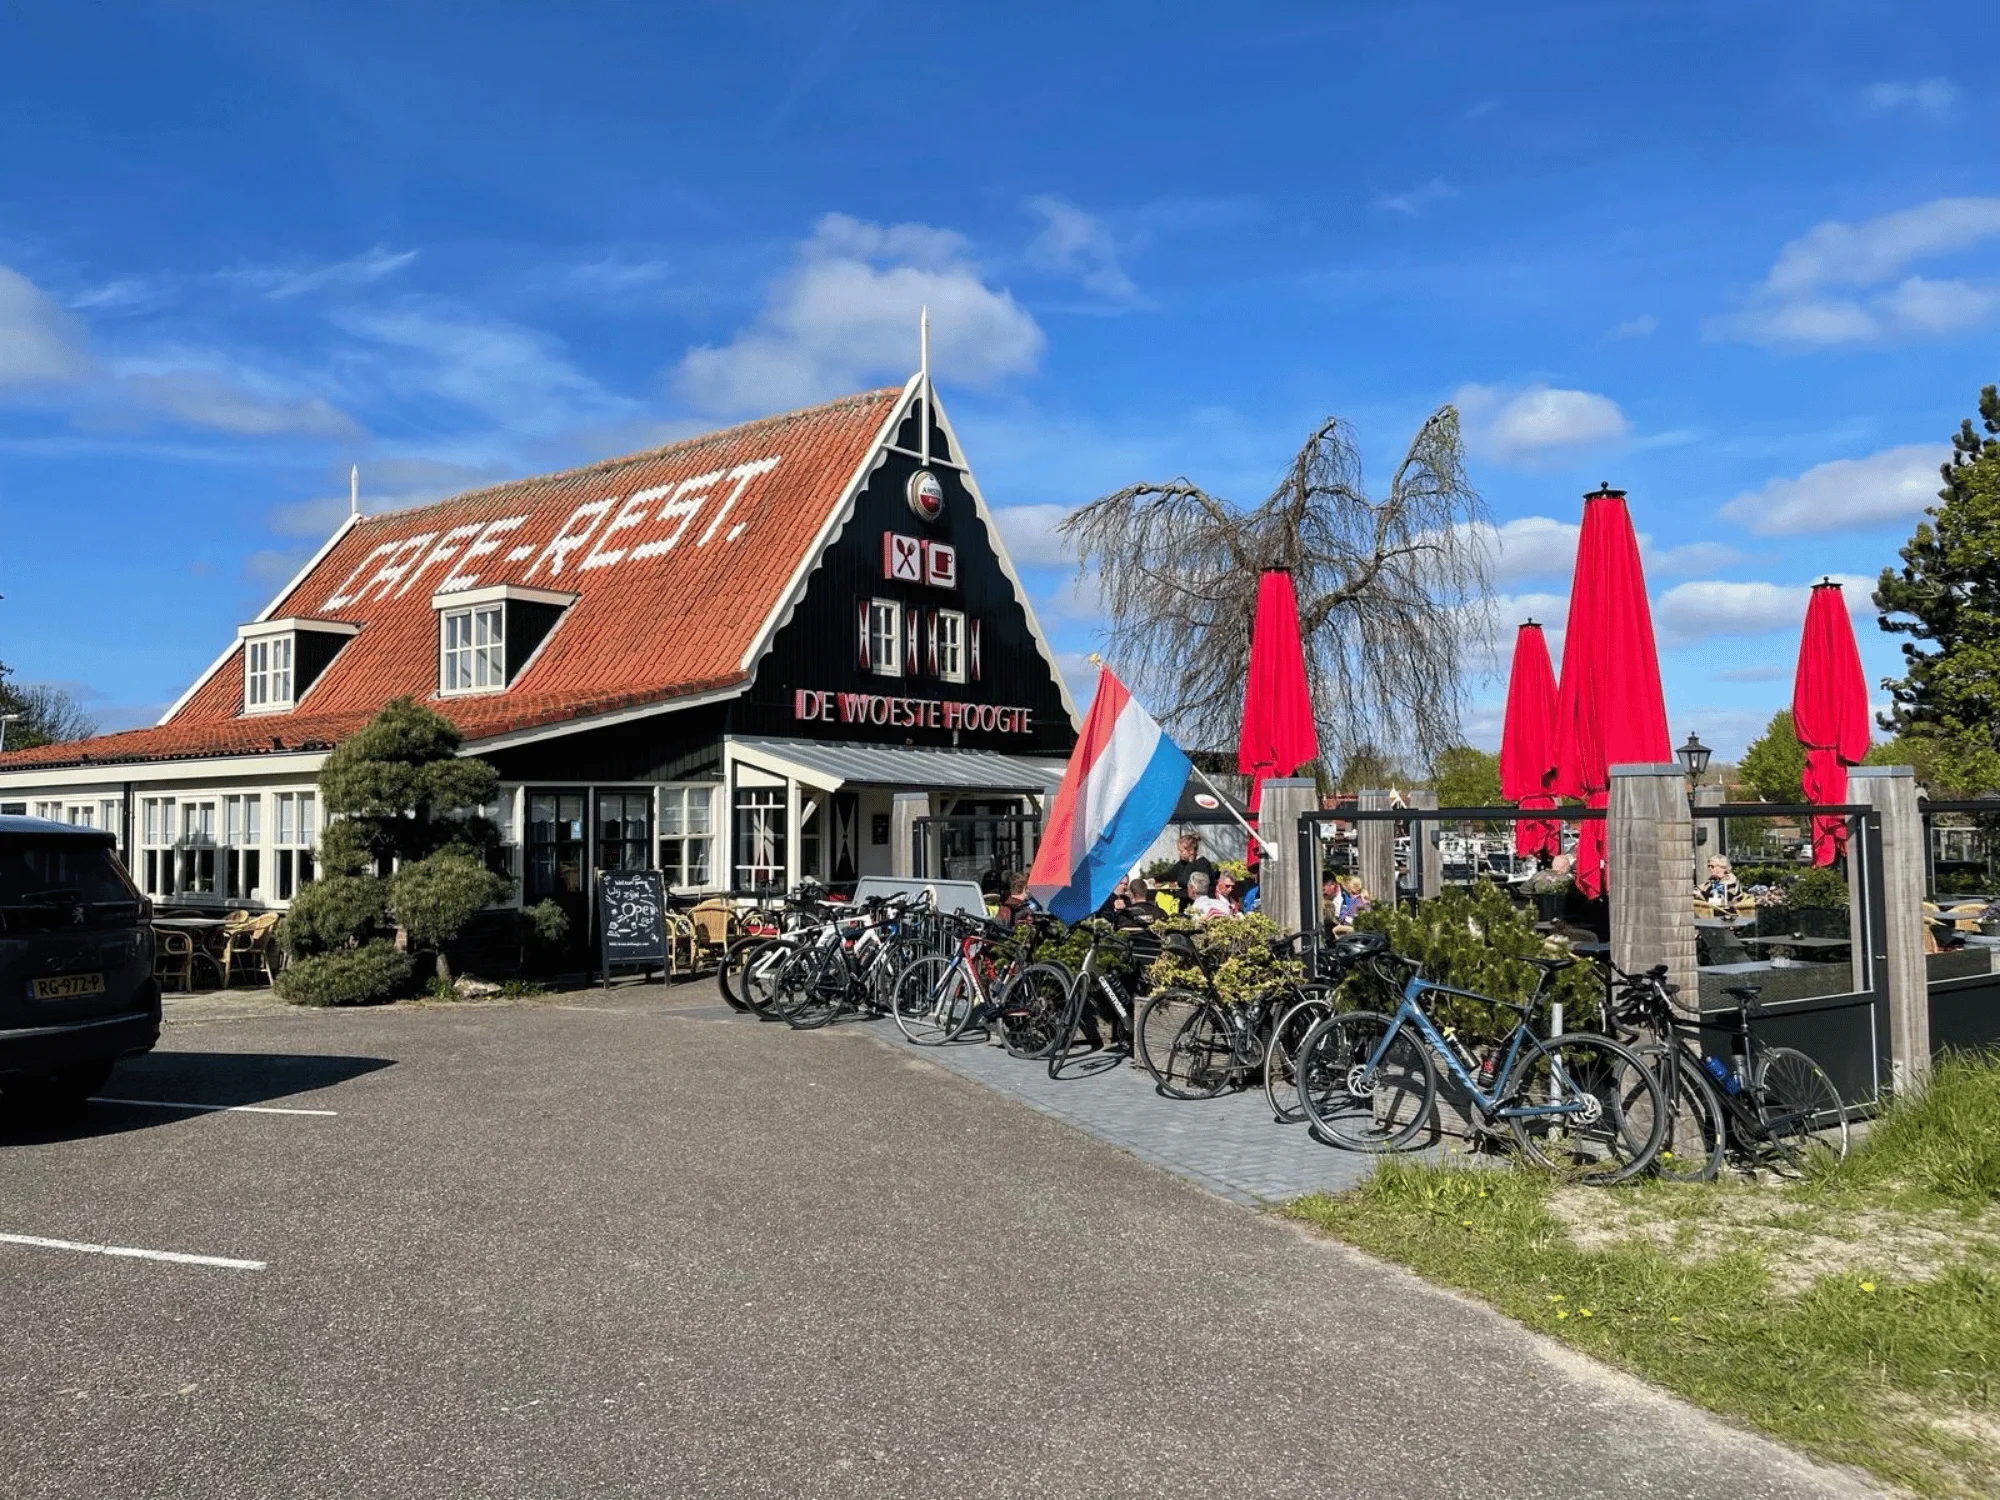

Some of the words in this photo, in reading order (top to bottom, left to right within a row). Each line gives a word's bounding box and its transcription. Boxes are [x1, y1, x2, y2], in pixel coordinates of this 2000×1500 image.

[795, 689, 835, 722] DE
[838, 693, 941, 727] WOESTE
[944, 701, 1033, 734] HOOGTE
